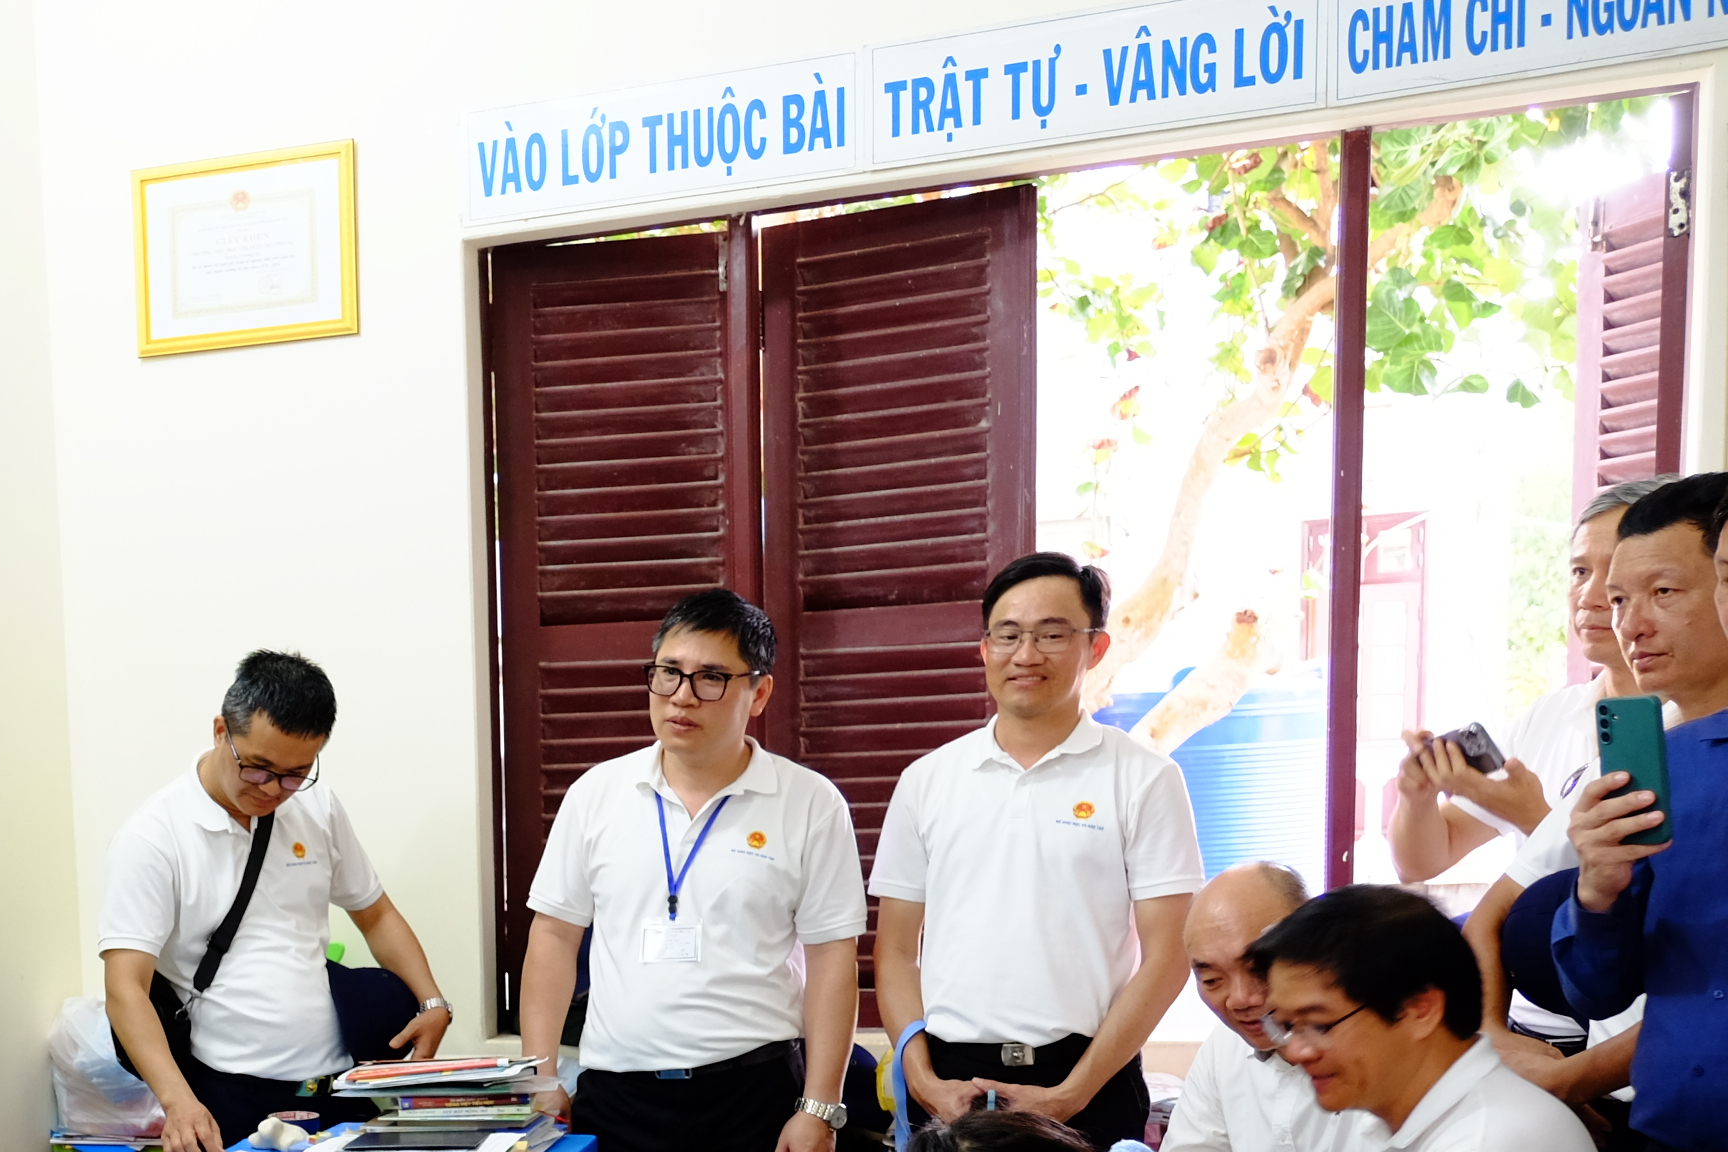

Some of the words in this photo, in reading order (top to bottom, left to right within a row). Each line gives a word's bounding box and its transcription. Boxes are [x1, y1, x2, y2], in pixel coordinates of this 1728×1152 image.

[478, 129, 547, 198] VÀO
[562, 107, 630, 187] LỚP
[642, 86, 767, 176] THUỘC
[782, 73, 846, 155] BÀI
[884, 56, 988, 142] TRẬT
[1004, 44, 1061, 130] TỰ
[1103, 26, 1217, 107] VÂNG
[1234, 6, 1304, 87] LỜI
